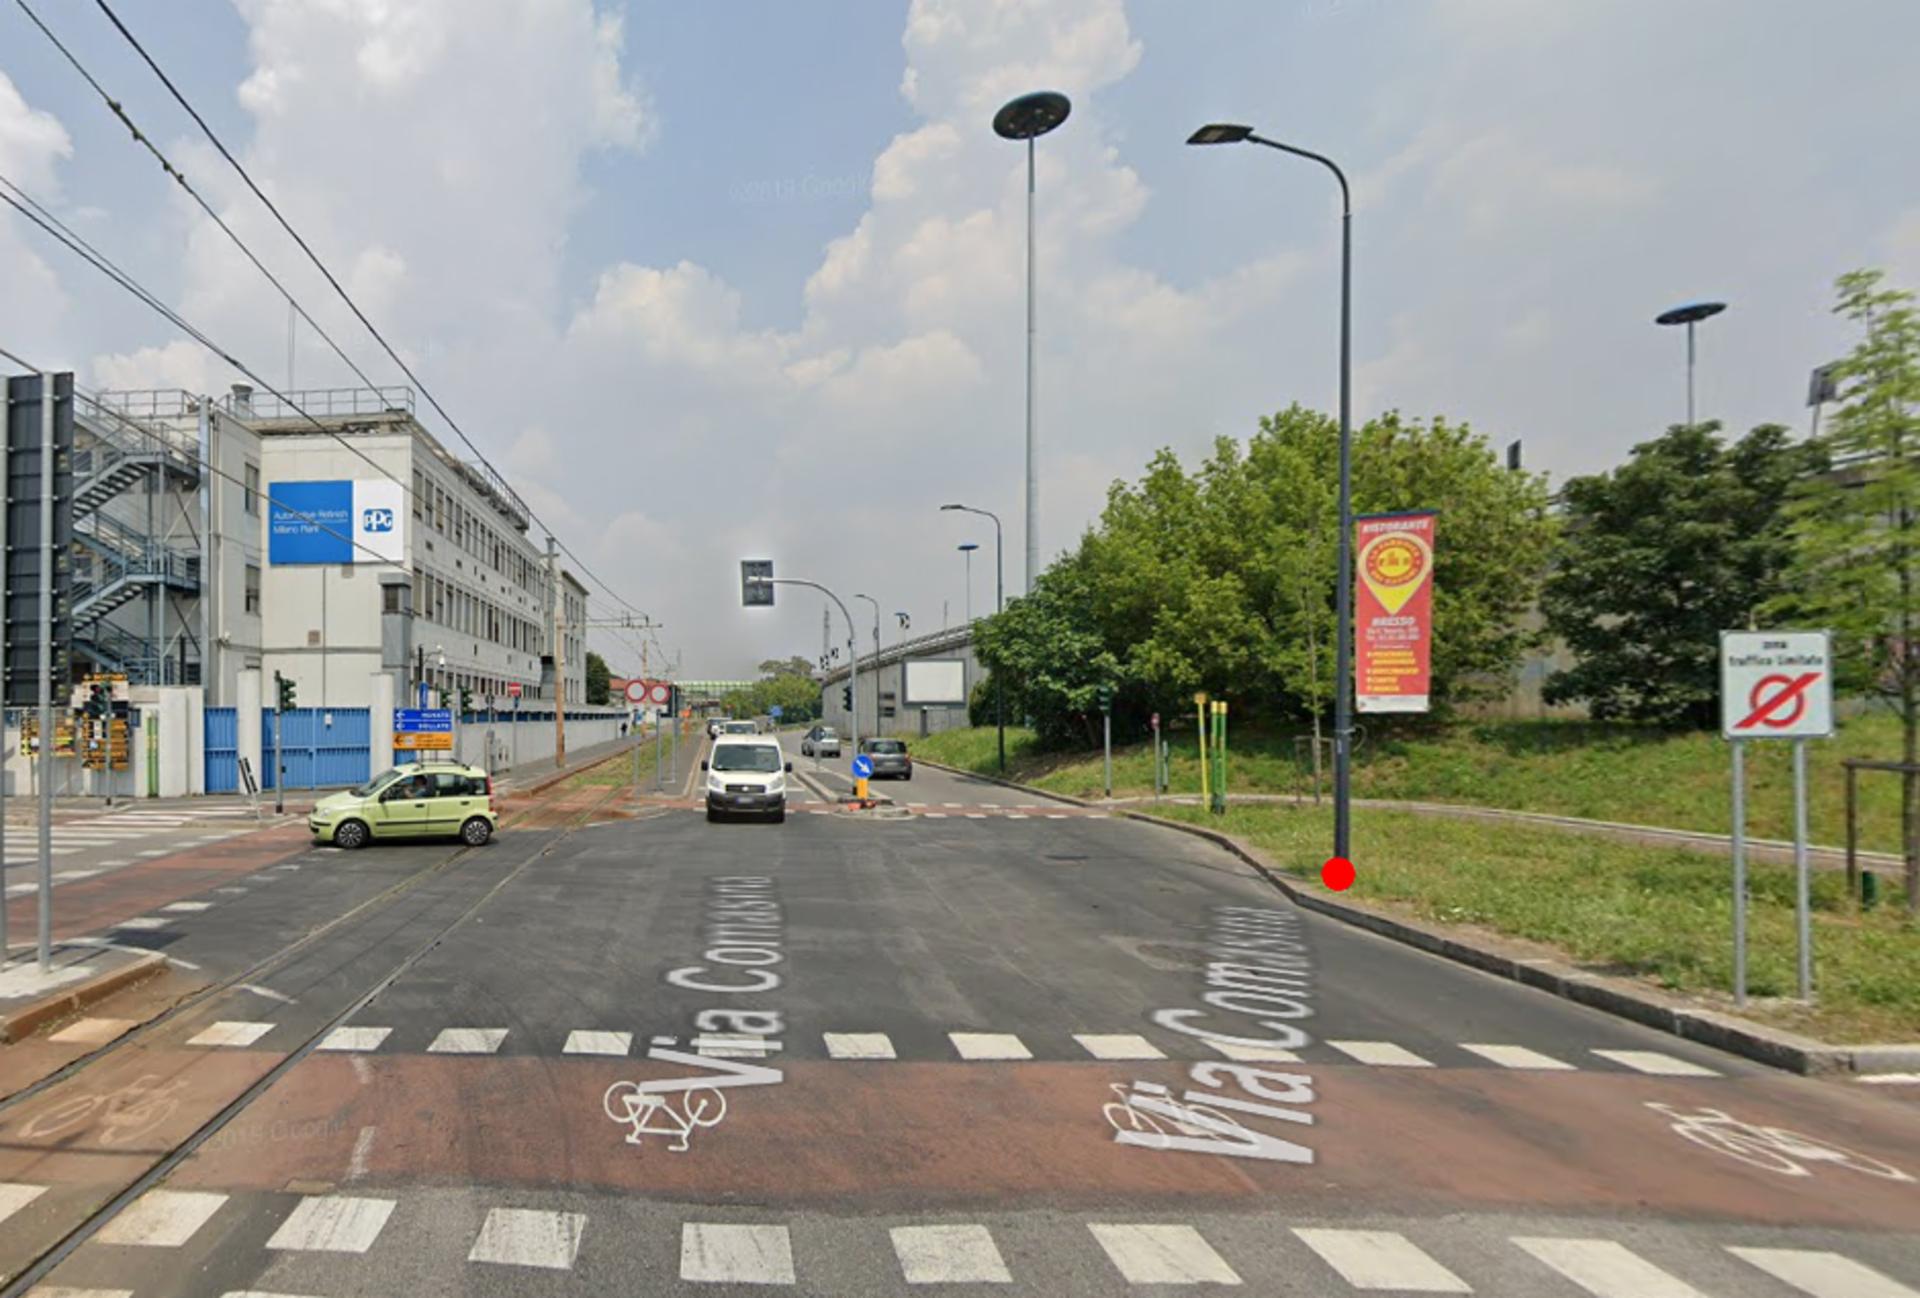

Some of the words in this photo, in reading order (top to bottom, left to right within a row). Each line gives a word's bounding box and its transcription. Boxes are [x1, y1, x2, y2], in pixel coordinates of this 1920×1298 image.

[364, 510, 392, 531] PPG
[1729, 654, 1772, 667] traffico
[1778, 654, 1823, 666] limitato
